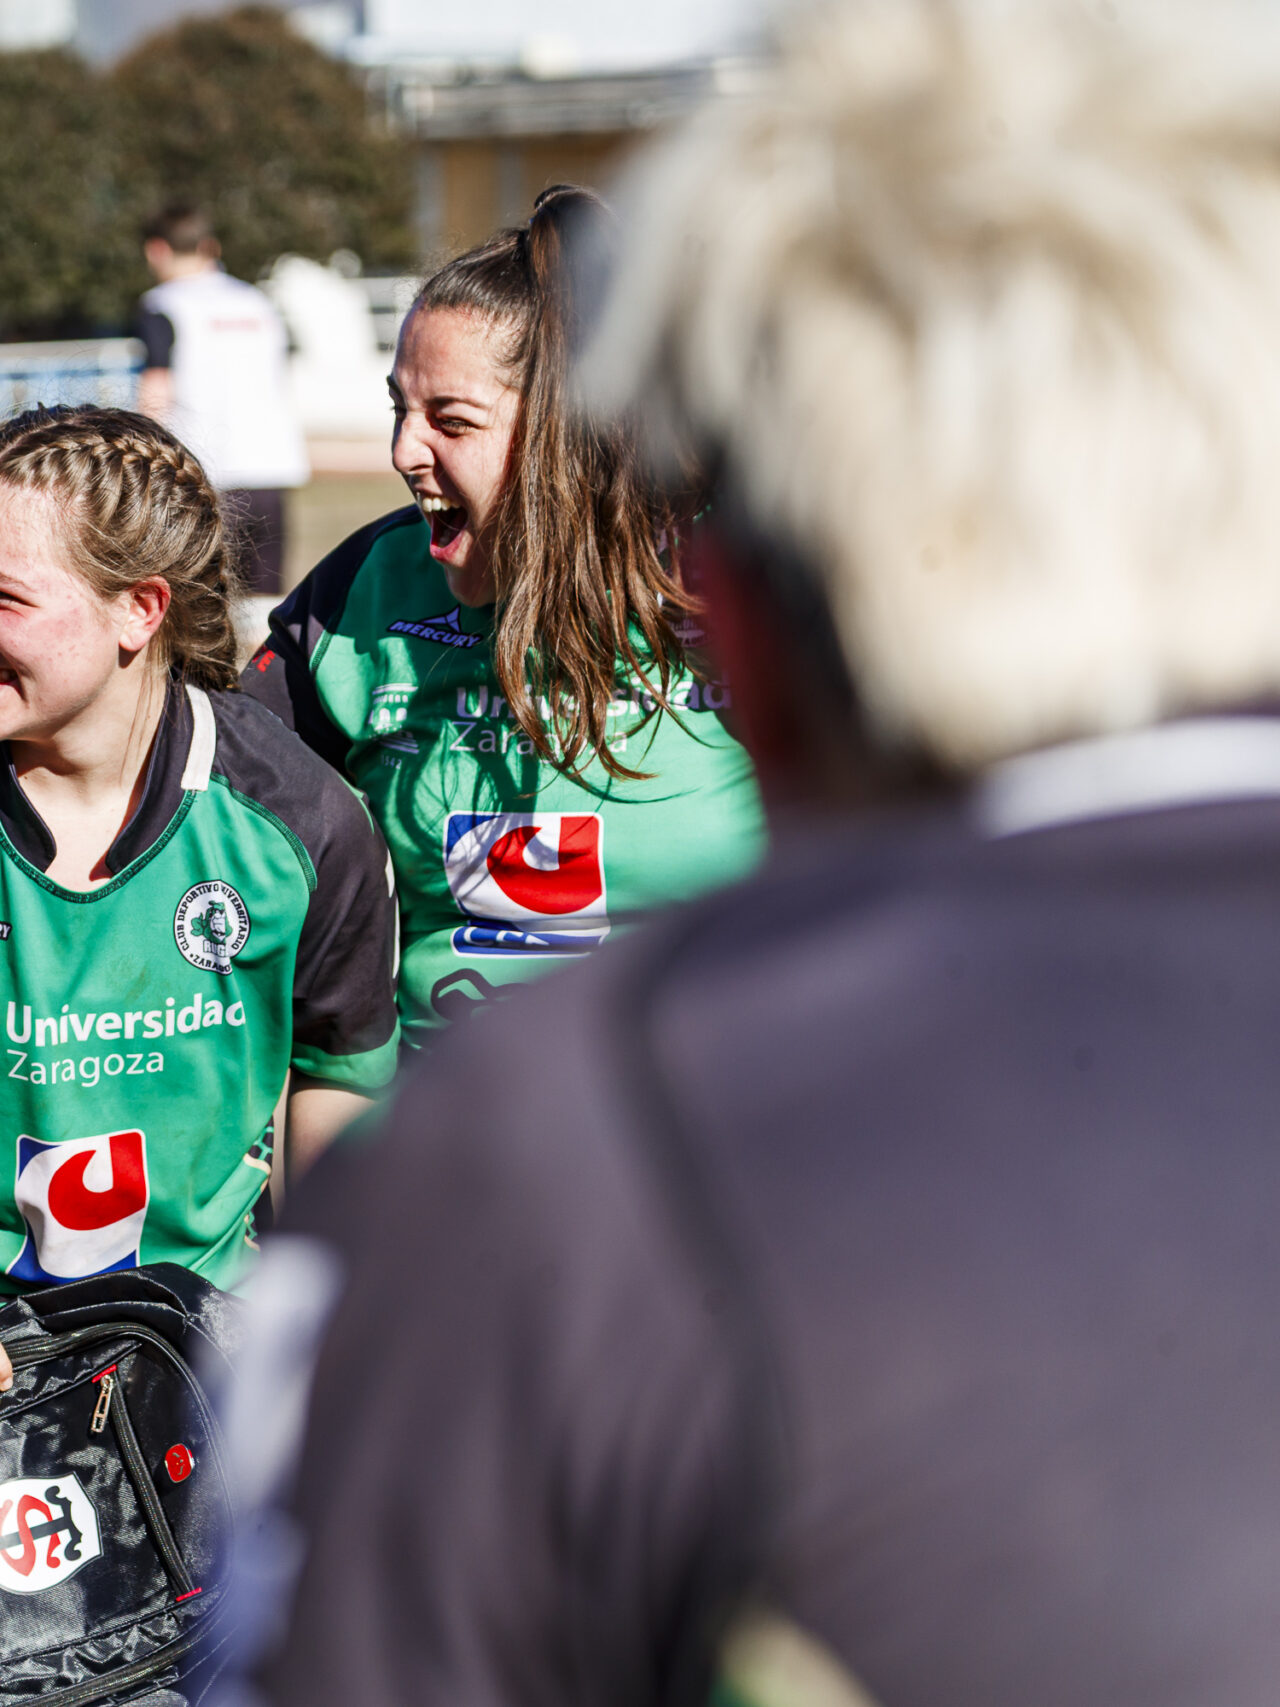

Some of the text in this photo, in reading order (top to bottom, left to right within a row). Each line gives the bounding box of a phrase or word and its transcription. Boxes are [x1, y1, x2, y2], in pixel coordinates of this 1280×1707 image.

[389, 621, 480, 647] MERCURY
[177, 884, 219, 921] DEPORTIVO
[177, 924, 189, 951] CLUB
[7, 1049, 164, 1088] Zaragoza
